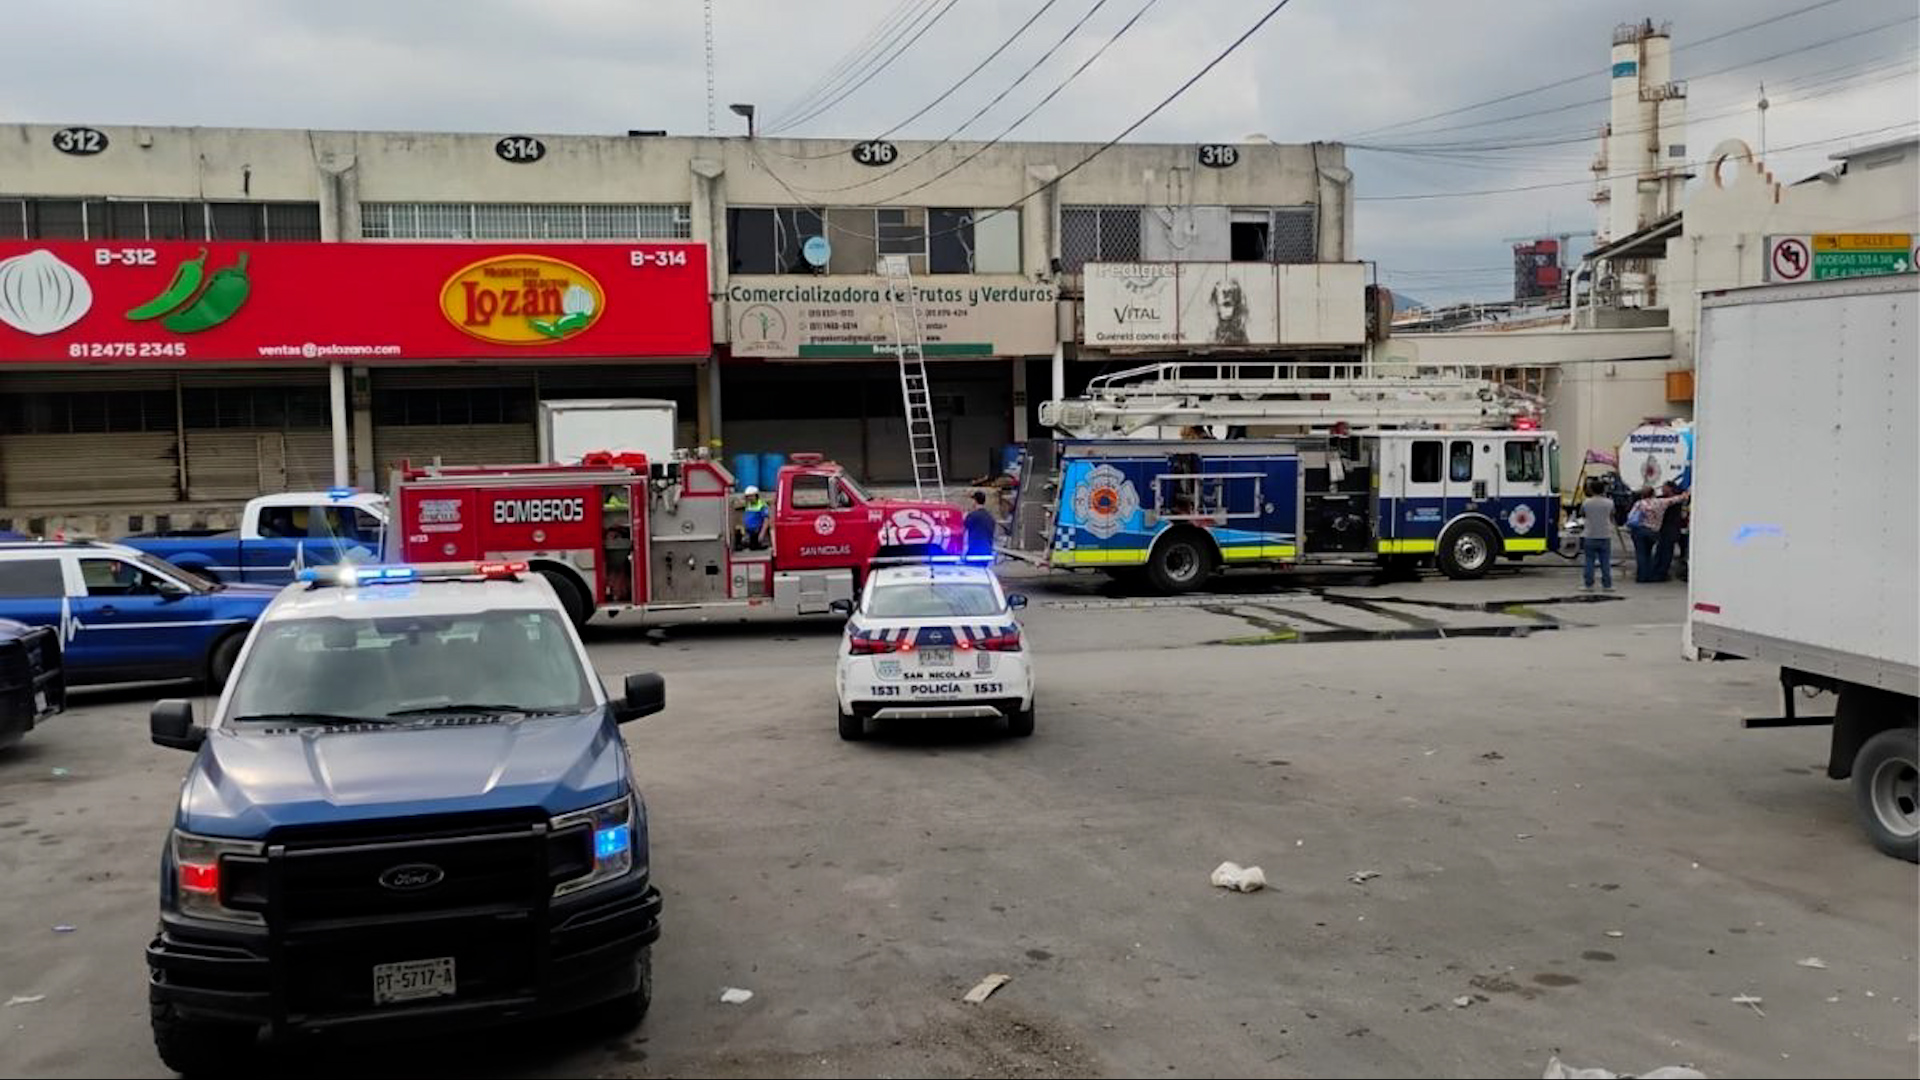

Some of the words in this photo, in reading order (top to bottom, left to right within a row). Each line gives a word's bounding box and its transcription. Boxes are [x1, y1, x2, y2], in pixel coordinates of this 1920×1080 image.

[59, 130, 100, 151] 312
[502, 139, 538, 159] 314
[859, 143, 892, 162] 316
[1203, 146, 1234, 164] 318
[95, 249, 156, 265] B-312
[631, 250, 687, 266] B-314
[731, 285, 879, 302] Comercializadora
[969, 289, 978, 306] y
[981, 286, 1053, 302] Verduras
[69, 343, 88, 356] 81
[91, 343, 137, 356] 2475
[140, 343, 186, 356] 2345
[258, 343, 400, 358] ventas@pslozano.com
[1630, 434, 1678, 443] BOMBEROS
[493, 498, 584, 523] BOMBEROS
[800, 546, 817, 556] SAN
[903, 671, 923, 680] SAN
[929, 669, 971, 679] NICOLÁS
[870, 685, 900, 696] 1531
[910, 682, 961, 694] POLICÍA
[974, 683, 1003, 694] 1531
[394, 872, 430, 885] Ford
[375, 967, 452, 993] PT-5717-A
